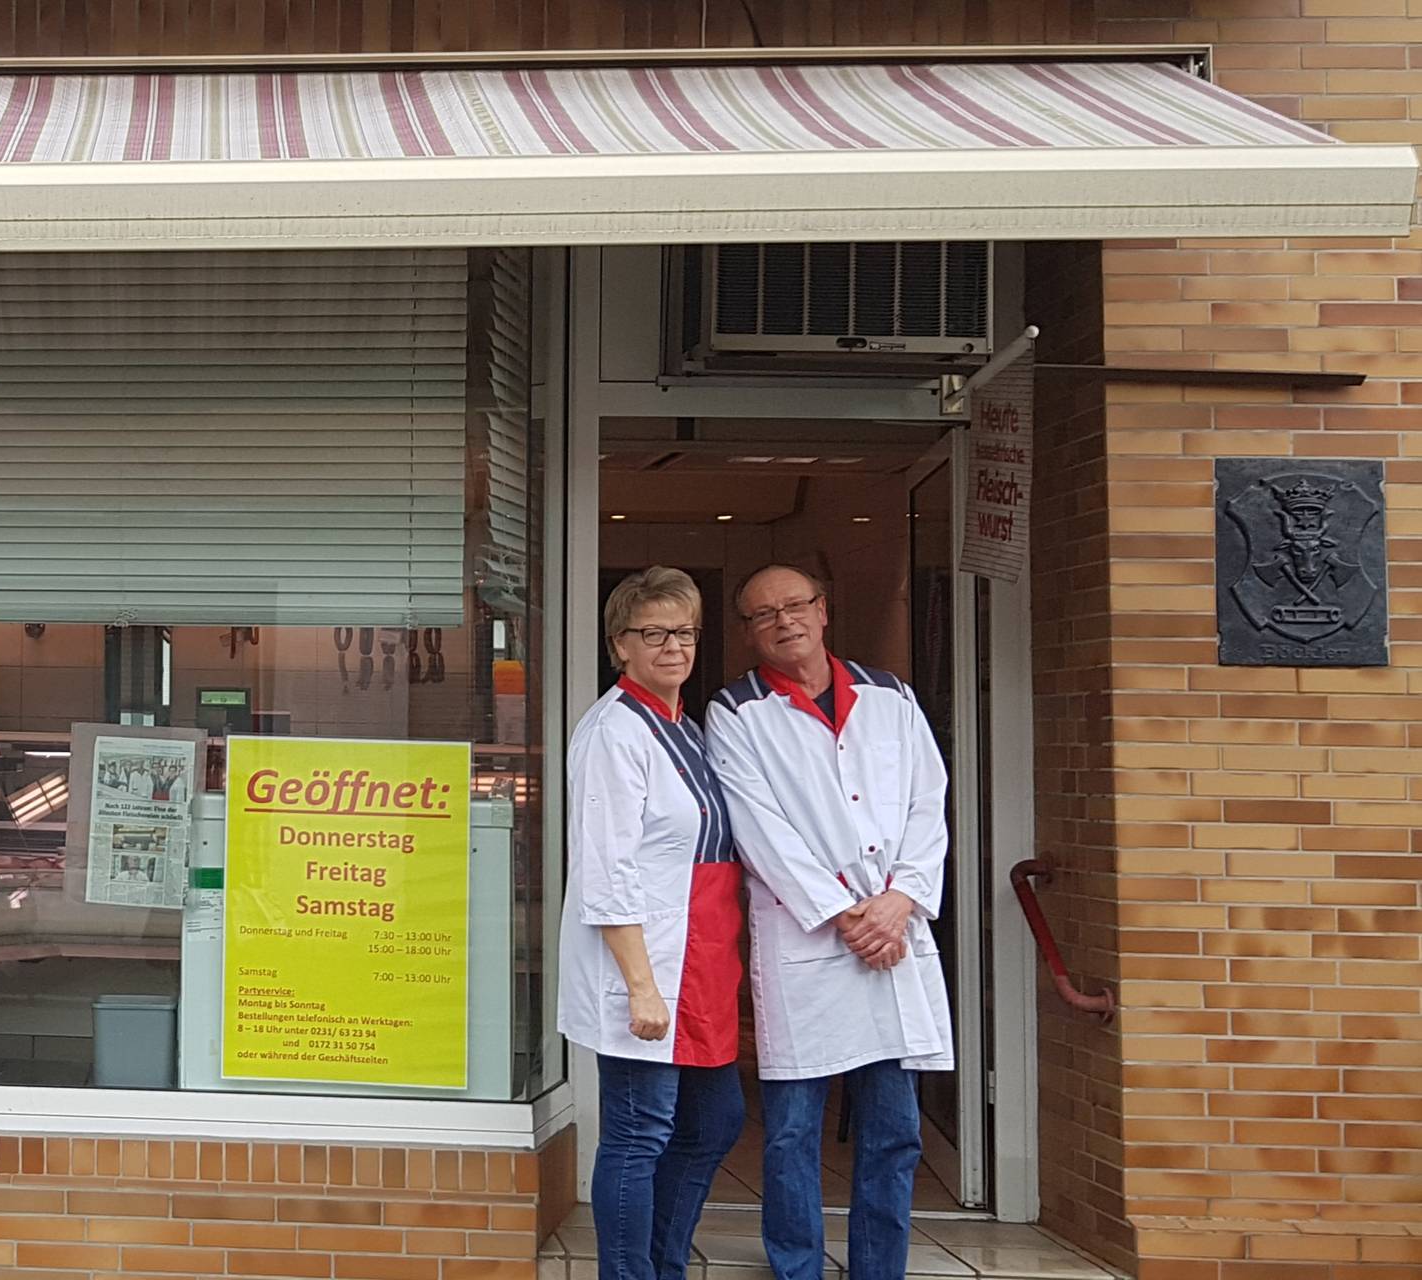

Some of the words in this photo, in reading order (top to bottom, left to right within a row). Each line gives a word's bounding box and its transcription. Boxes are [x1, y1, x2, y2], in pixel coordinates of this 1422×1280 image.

[980, 401, 1019, 433] Heute
[978, 469, 1023, 506] Fleisch-
[246, 768, 451, 815] Geöffnet:
[280, 826, 415, 853] Donnerstag
[306, 861, 386, 887] Freitag
[296, 895, 395, 922] Samstag
[240, 925, 293, 937] Donnerstag
[295, 927, 313, 937] und
[315, 929, 347, 940] Freitag
[373, 930, 395, 940] 7:30
[406, 932, 431, 941] 13:00
[434, 933, 452, 942] Uhr
[368, 944, 394, 954] 15:00
[405, 946, 431, 955] 18:00
[434, 947, 452, 956] Uhr
[238, 967, 278, 978] Samstag
[373, 972, 394, 981] 7:00
[405, 974, 431, 983] 13:00
[433, 975, 451, 984] Uhr
[238, 986, 295, 998] Partyservice:
[238, 999, 272, 1009] Montag
[275, 1000, 287, 1008] bis
[289, 1000, 325, 1011] Sonntag
[238, 1011, 294, 1022] Bestellungen
[297, 1014, 345, 1024] telefonisch
[348, 1017, 358, 1025] an
[361, 1016, 414, 1028] Werktagen:
[237, 1024, 243, 1032] 8
[253, 1025, 264, 1033] 18
[266, 1025, 282, 1034] Uhr
[284, 1026, 309, 1035] unter
[310, 1027, 337, 1037] 0231/
[339, 1028, 350, 1037] 63
[352, 1029, 363, 1037] 23
[365, 1029, 377, 1038] 94
[283, 1039, 300, 1047] und
[309, 1040, 330, 1049] 0172
[333, 1041, 343, 1049] 31
[346, 1042, 357, 1050] 50
[359, 1042, 375, 1050] 754
[237, 1050, 257, 1059] oder
[260, 1051, 299, 1060] während
[301, 1053, 316, 1061] der
[318, 1053, 388, 1065] Geschäftszeiten
